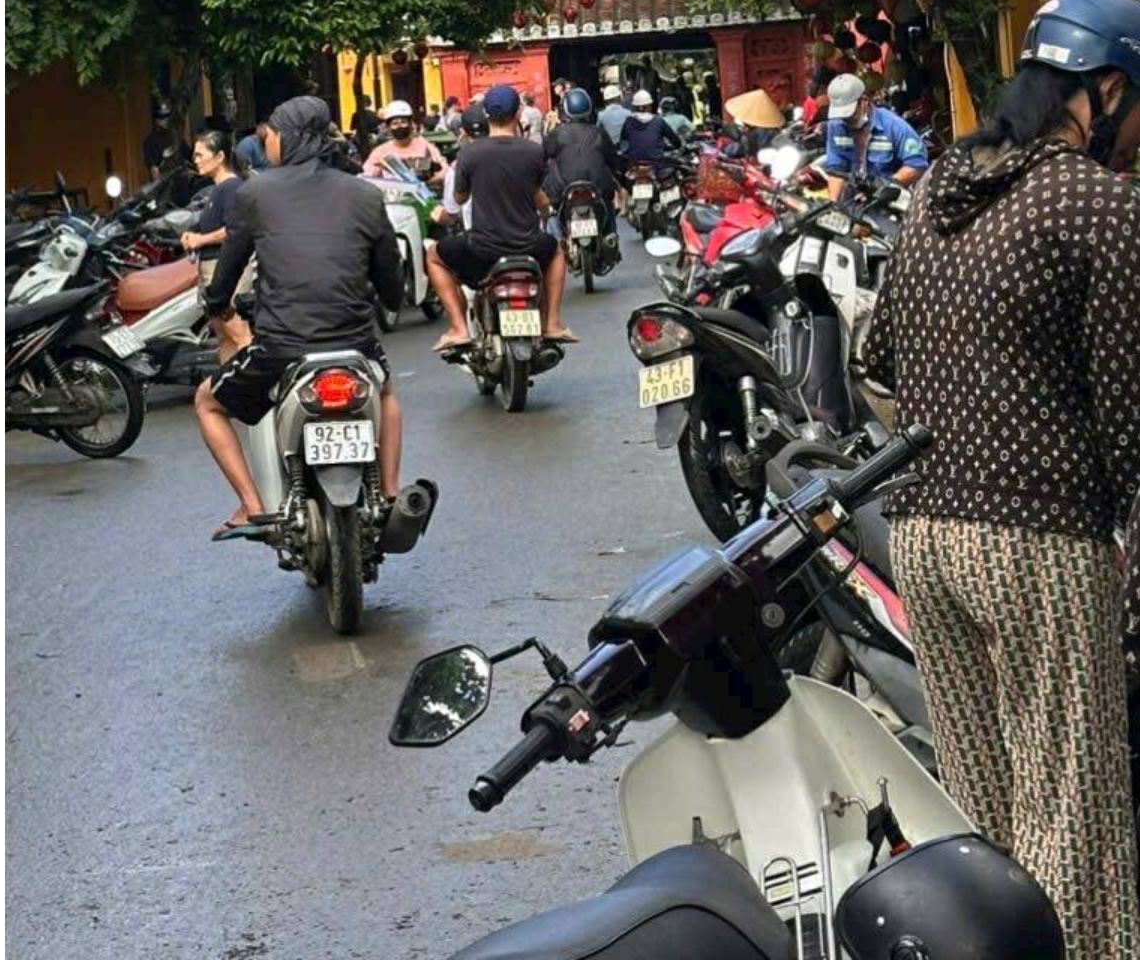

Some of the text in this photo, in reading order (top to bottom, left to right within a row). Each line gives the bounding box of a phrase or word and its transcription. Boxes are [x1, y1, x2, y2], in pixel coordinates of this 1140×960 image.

[646, 359, 684, 385] 43-F1
[315, 425, 360, 442] 92-C1
[310, 441, 369, 460] 397.37
